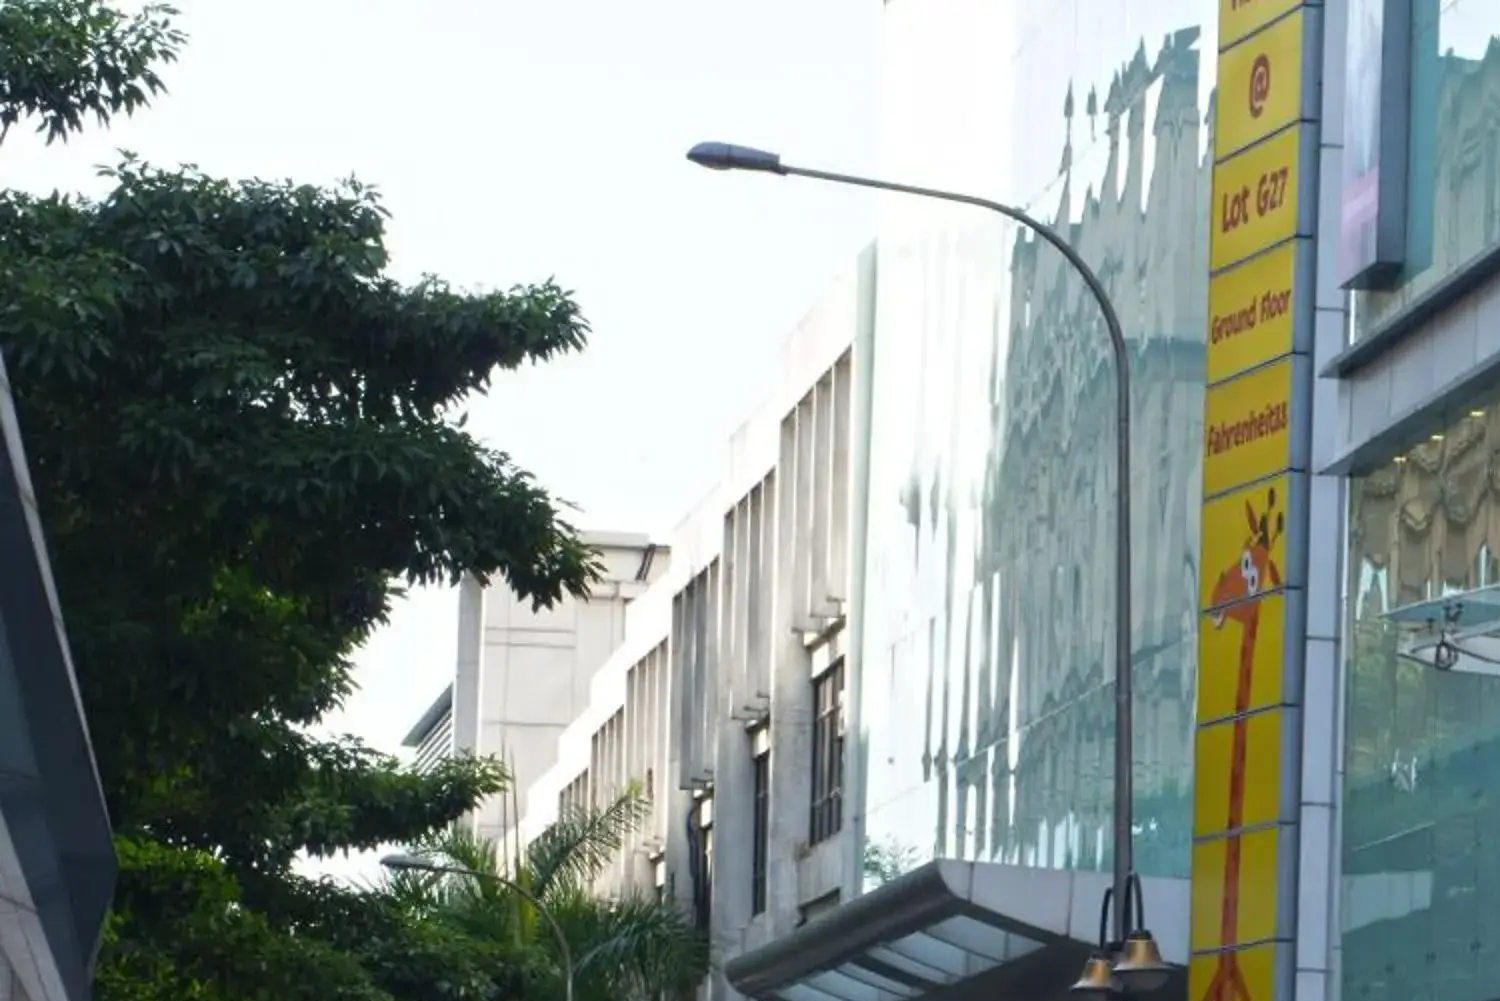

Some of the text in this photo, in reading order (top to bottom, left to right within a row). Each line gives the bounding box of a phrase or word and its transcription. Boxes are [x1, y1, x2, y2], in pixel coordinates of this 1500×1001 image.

[1221, 166, 1290, 233] Lot G27
[1211, 290, 1291, 345] Ground Floor
